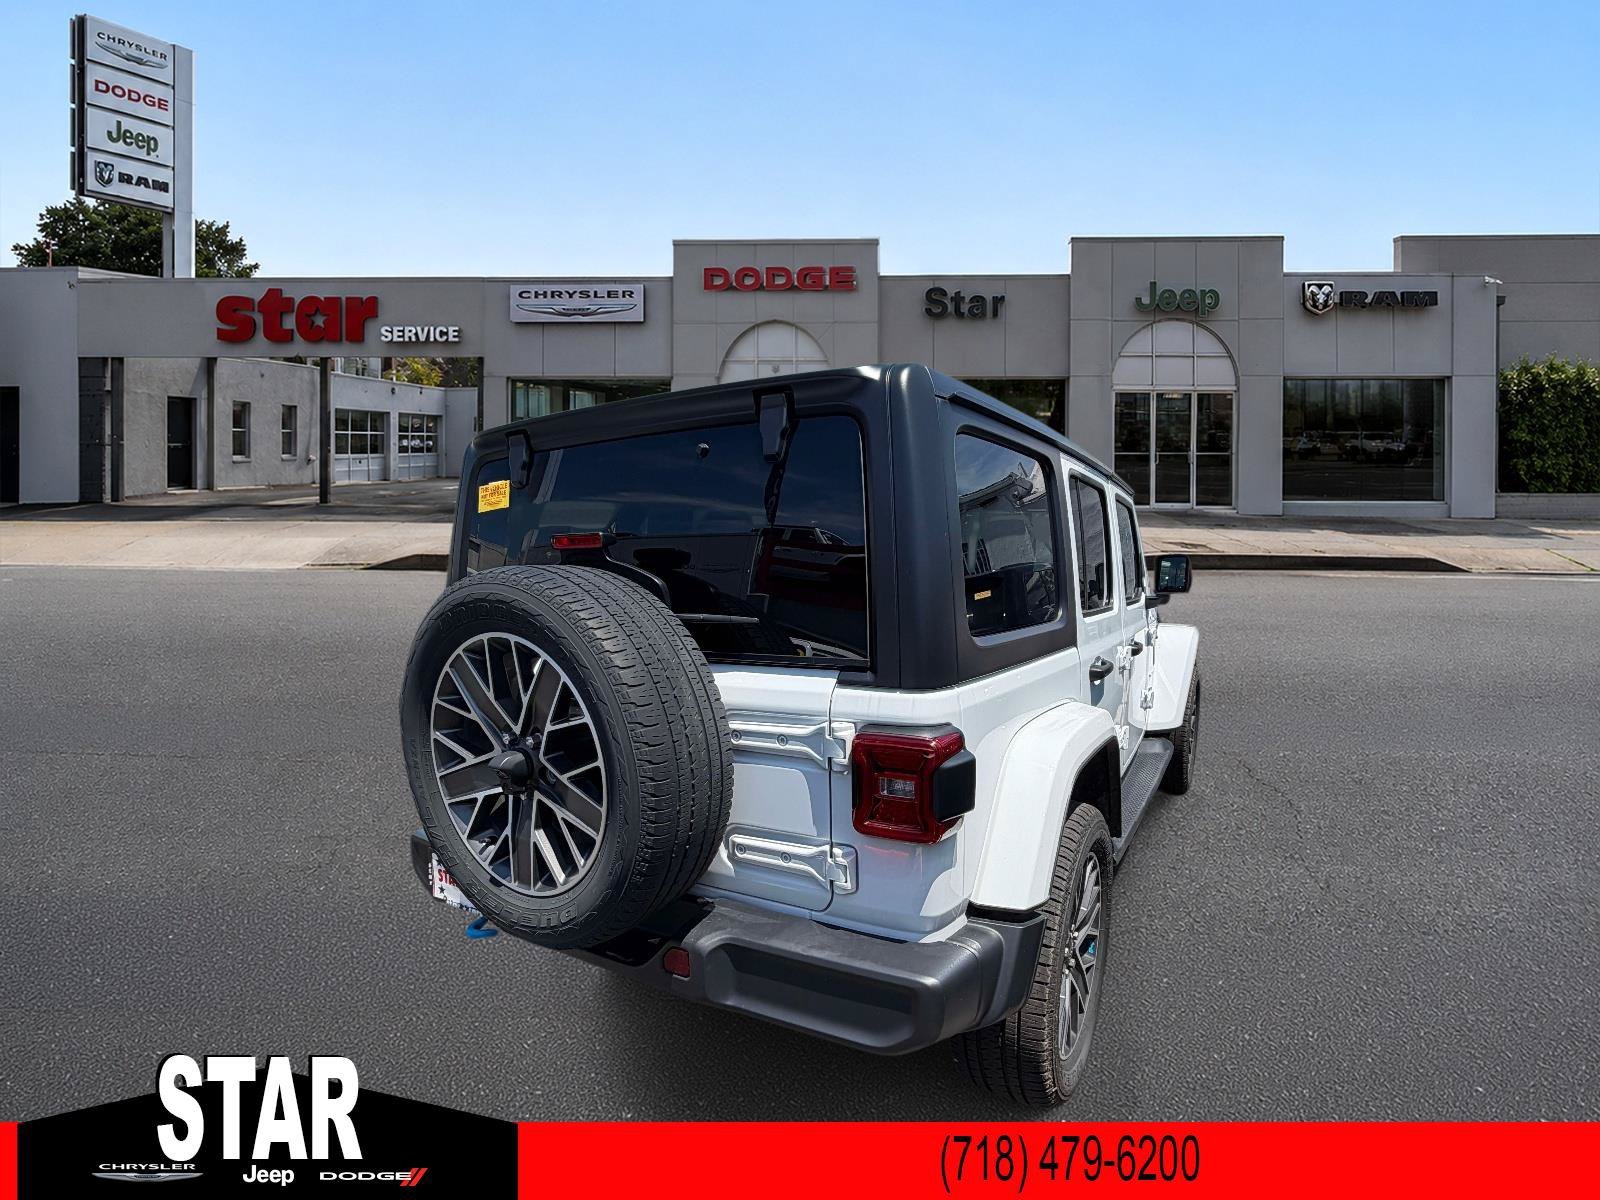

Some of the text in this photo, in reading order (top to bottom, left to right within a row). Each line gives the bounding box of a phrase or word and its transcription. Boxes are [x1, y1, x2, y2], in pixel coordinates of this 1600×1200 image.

[97, 31, 168, 61] CHRYSLER
[94, 79, 169, 111] DODGE
[107, 120, 159, 156] Jeep
[118, 171, 169, 193] RAM
[518, 289, 635, 299] CHRYSLER
[703, 266, 857, 291] DODGE
[924, 286, 1005, 319] Star
[1134, 281, 1220, 317] Jeep
[1339, 290, 1439, 308] RAM
[215, 287, 461, 344] star SERVICE
